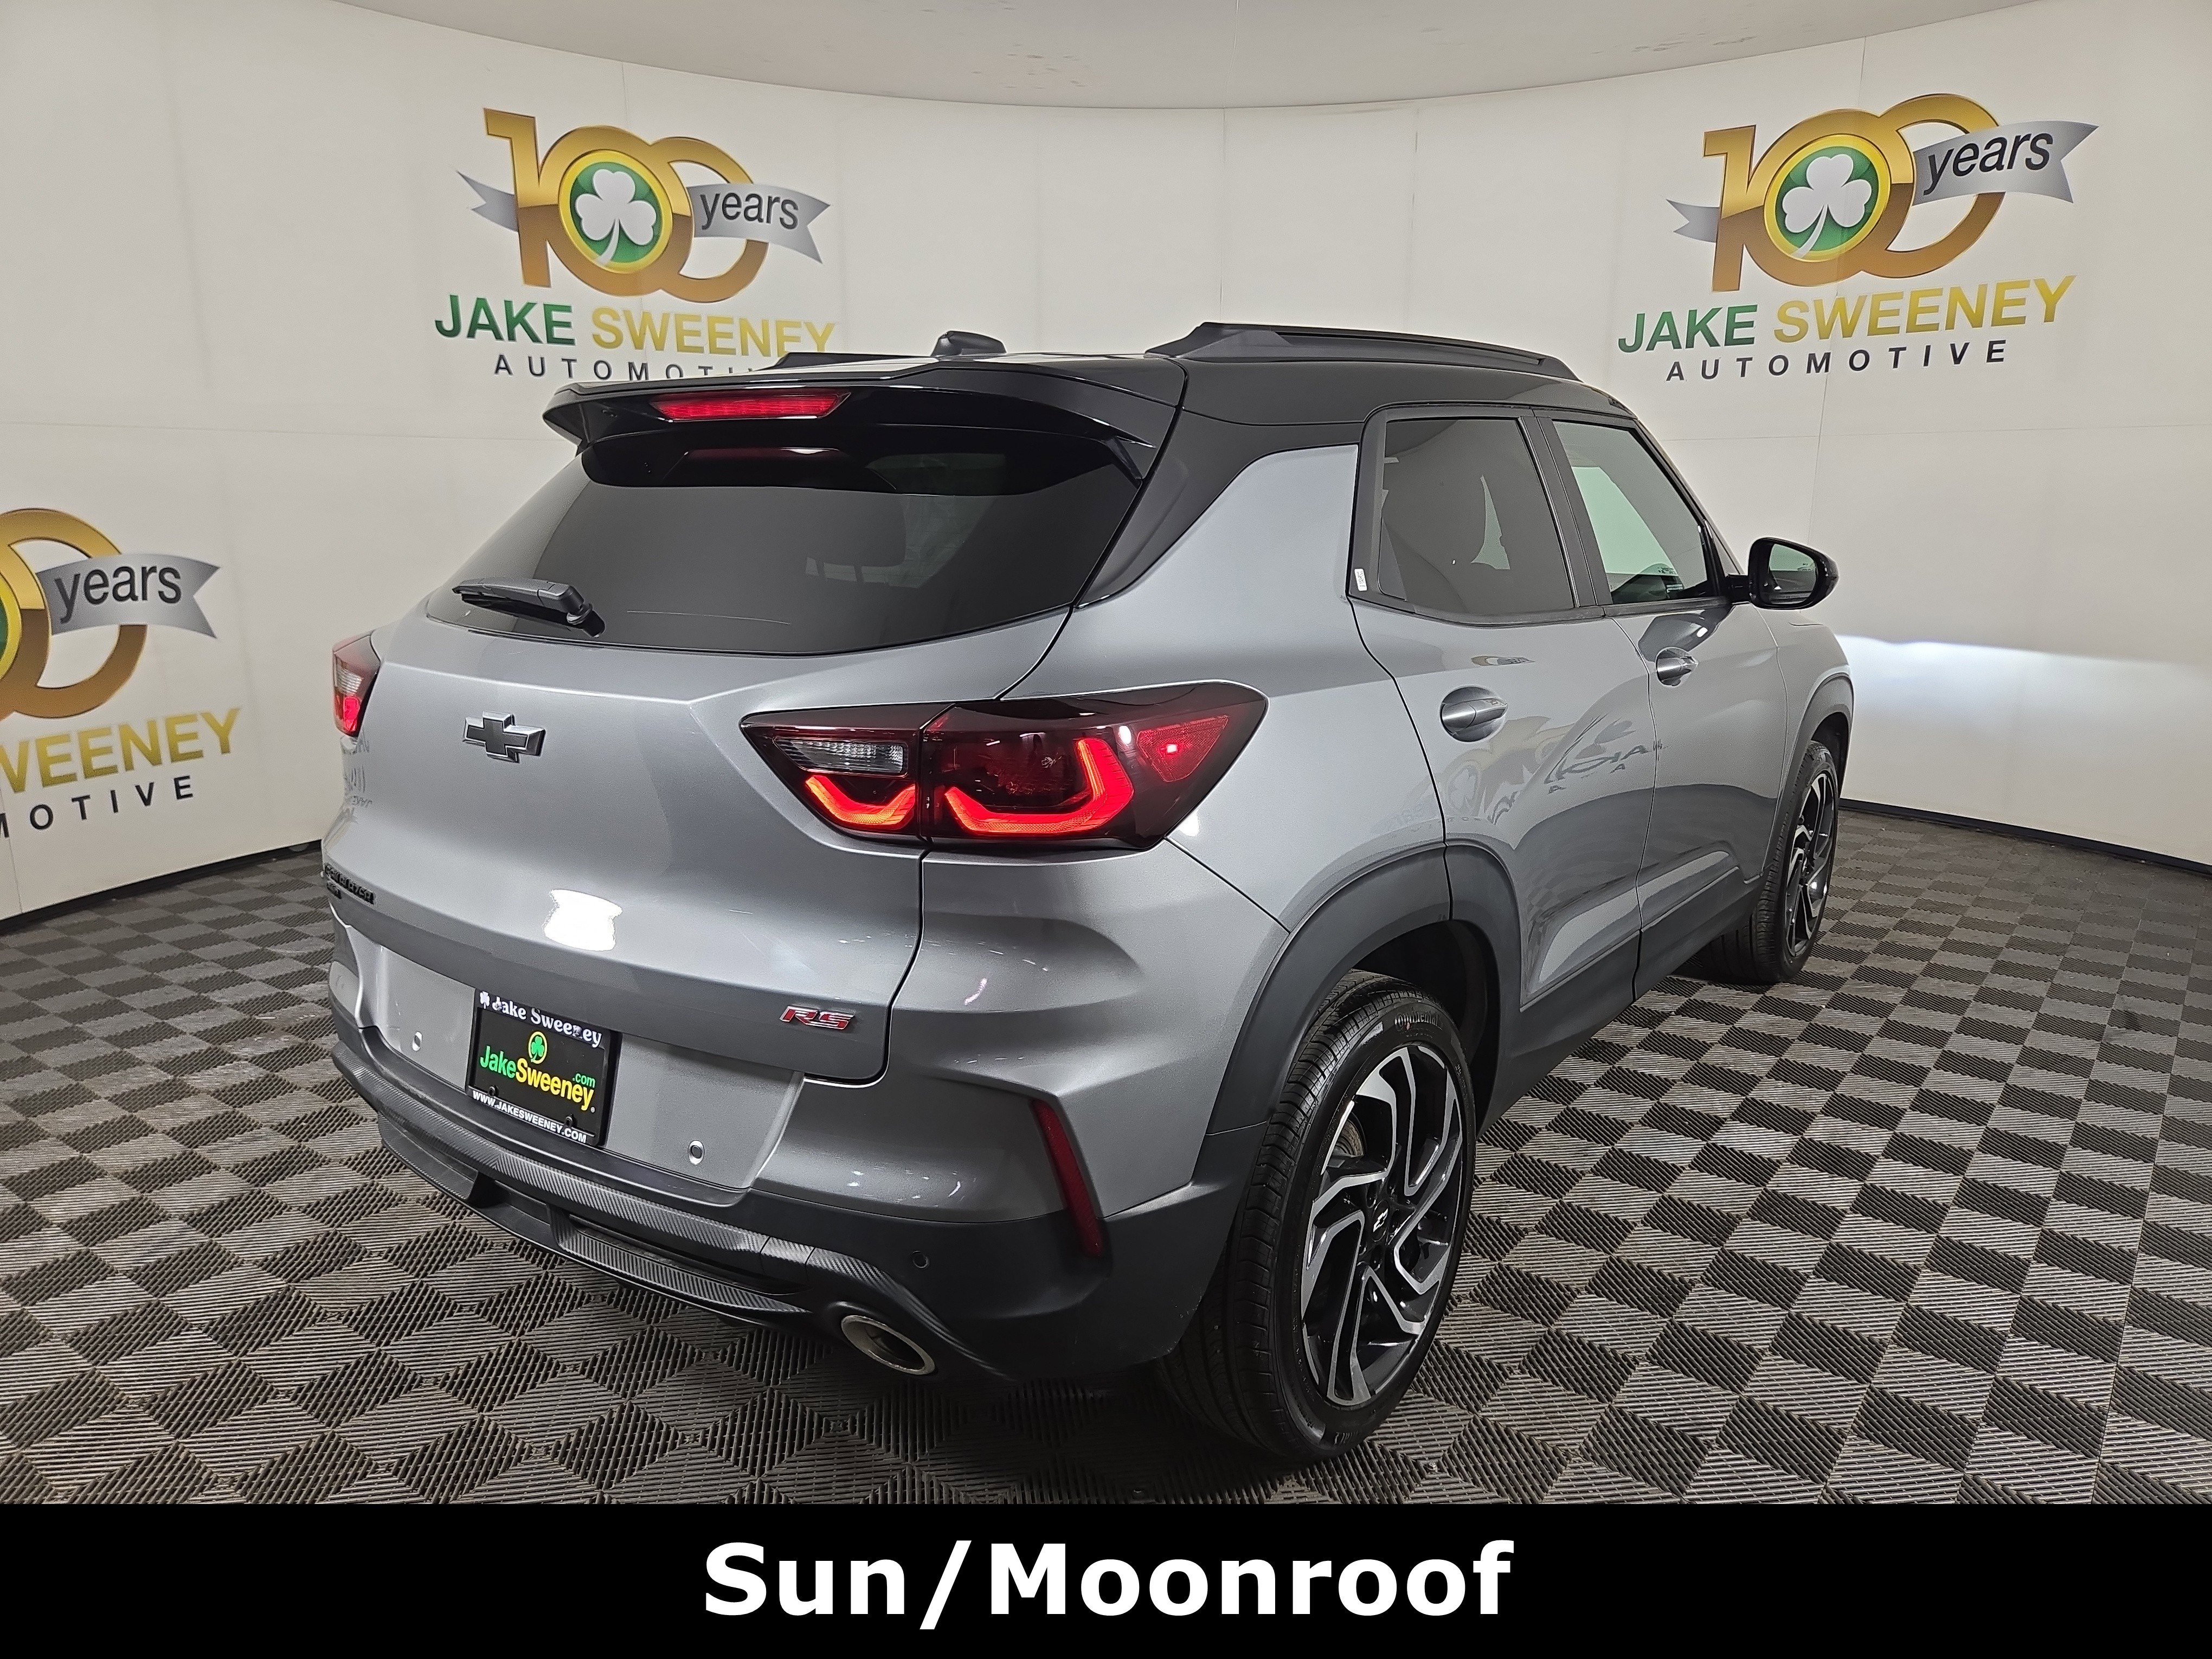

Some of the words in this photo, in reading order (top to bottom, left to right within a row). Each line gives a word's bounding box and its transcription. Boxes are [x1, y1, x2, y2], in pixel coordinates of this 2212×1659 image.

[483, 108, 769, 303] 100
[699, 192, 799, 230] years
[1704, 93, 2002, 292] 100
[1924, 132, 2053, 195] years
[435, 294, 575, 345] JAKE
[591, 307, 835, 358] SWEENEY
[1618, 304, 1758, 353] JAKE
[1773, 275, 2076, 343] SWEENEY
[494, 354, 753, 381] AUTOMOT
[1666, 340, 2007, 382] AUTOMOTIVE
[54, 565, 181, 623] years
[0, 708, 240, 793] EENEY
[492, 996, 526, 1020] Jake
[779, 1006, 855, 1030] RS
[473, 1090, 587, 1143] WWW.JAKESWEENEY.COM
